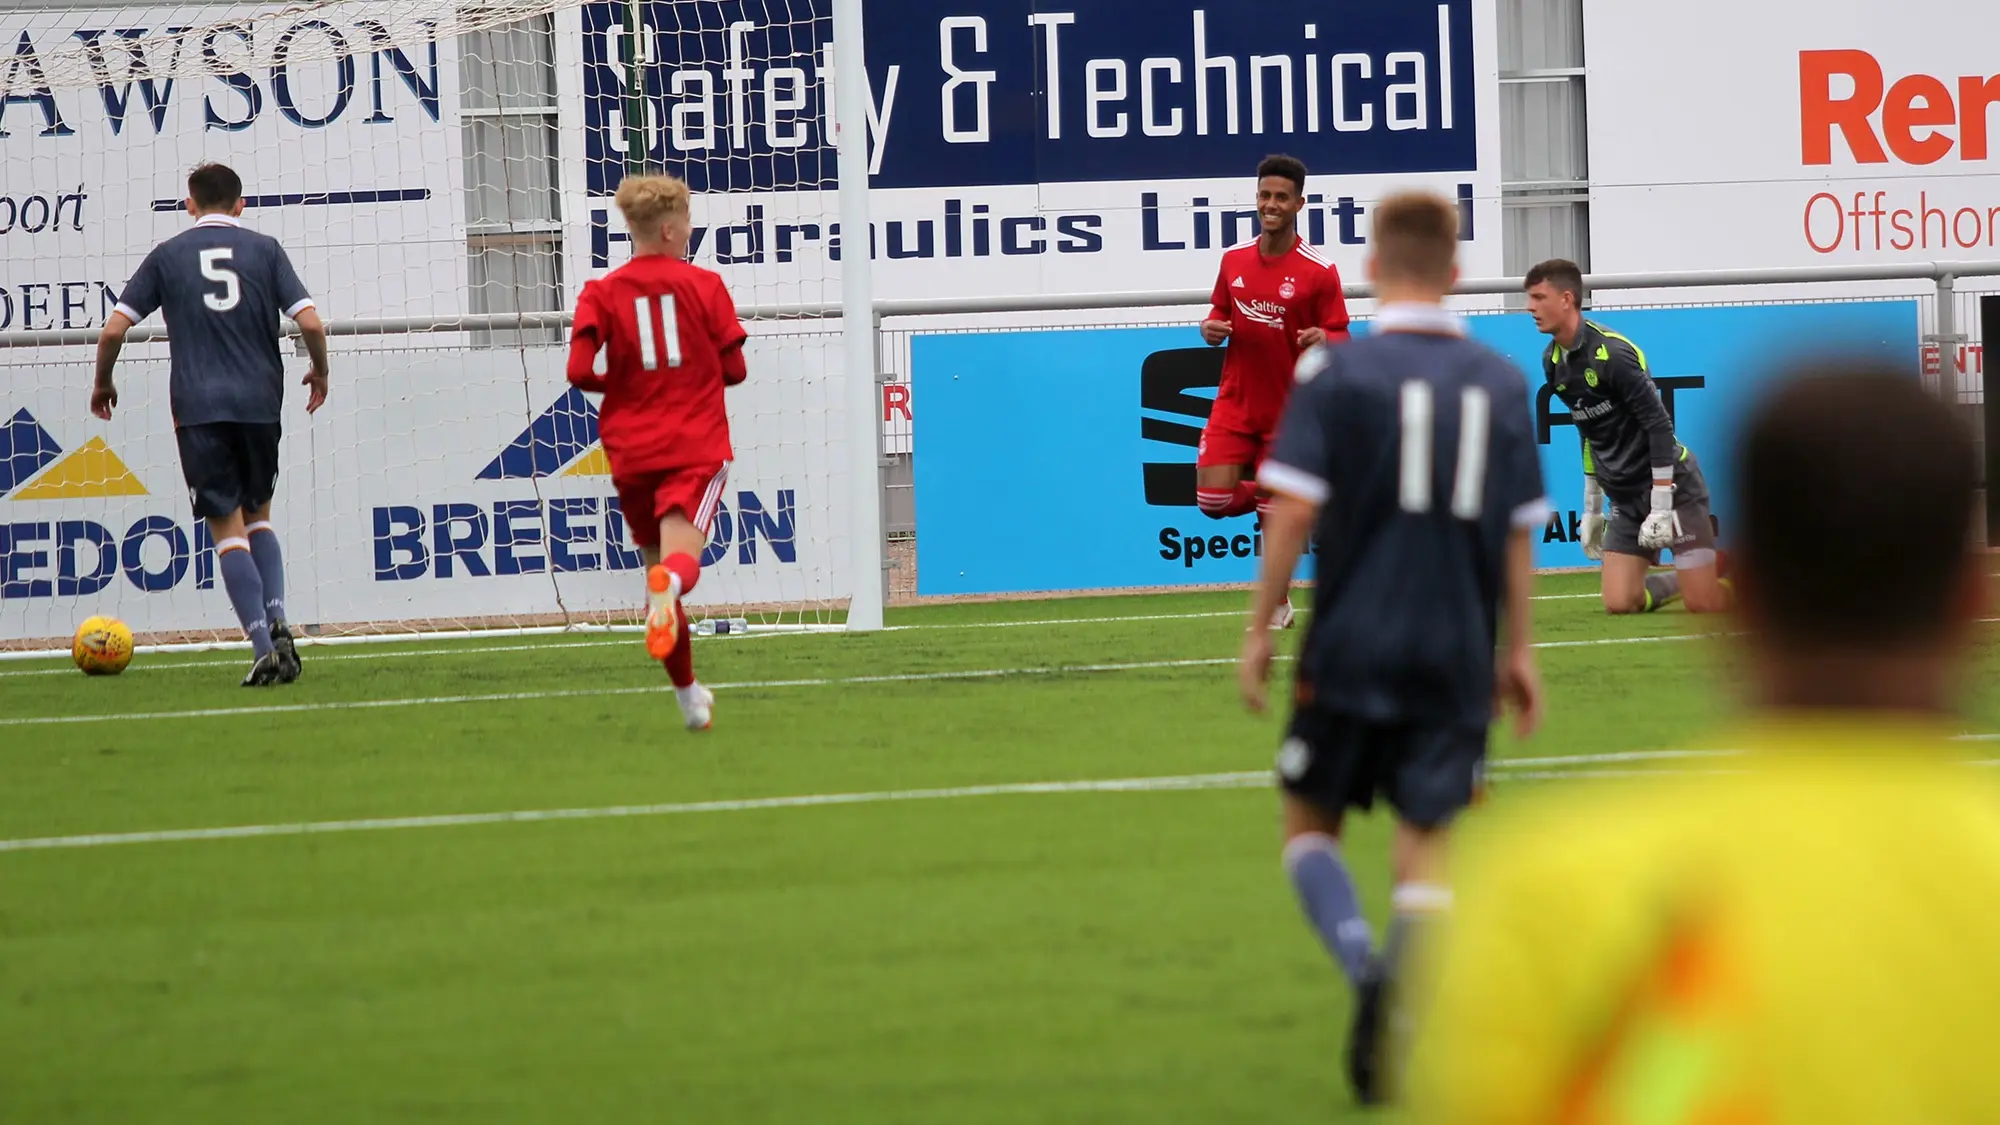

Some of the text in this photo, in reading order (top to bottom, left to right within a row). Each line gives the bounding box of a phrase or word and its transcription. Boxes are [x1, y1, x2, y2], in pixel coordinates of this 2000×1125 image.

[0, 18, 440, 137] AWSON
[939, 16, 996, 143] &
[1028, 4, 1453, 140] Technical
[1141, 183, 1475, 251] Liit
[1803, 190, 2000, 254] Offshor
[199, 247, 240, 311] 5
[1250, 299, 1286, 315] Saltire
[634, 293, 682, 371] 11
[1398, 378, 1491, 521] 11
